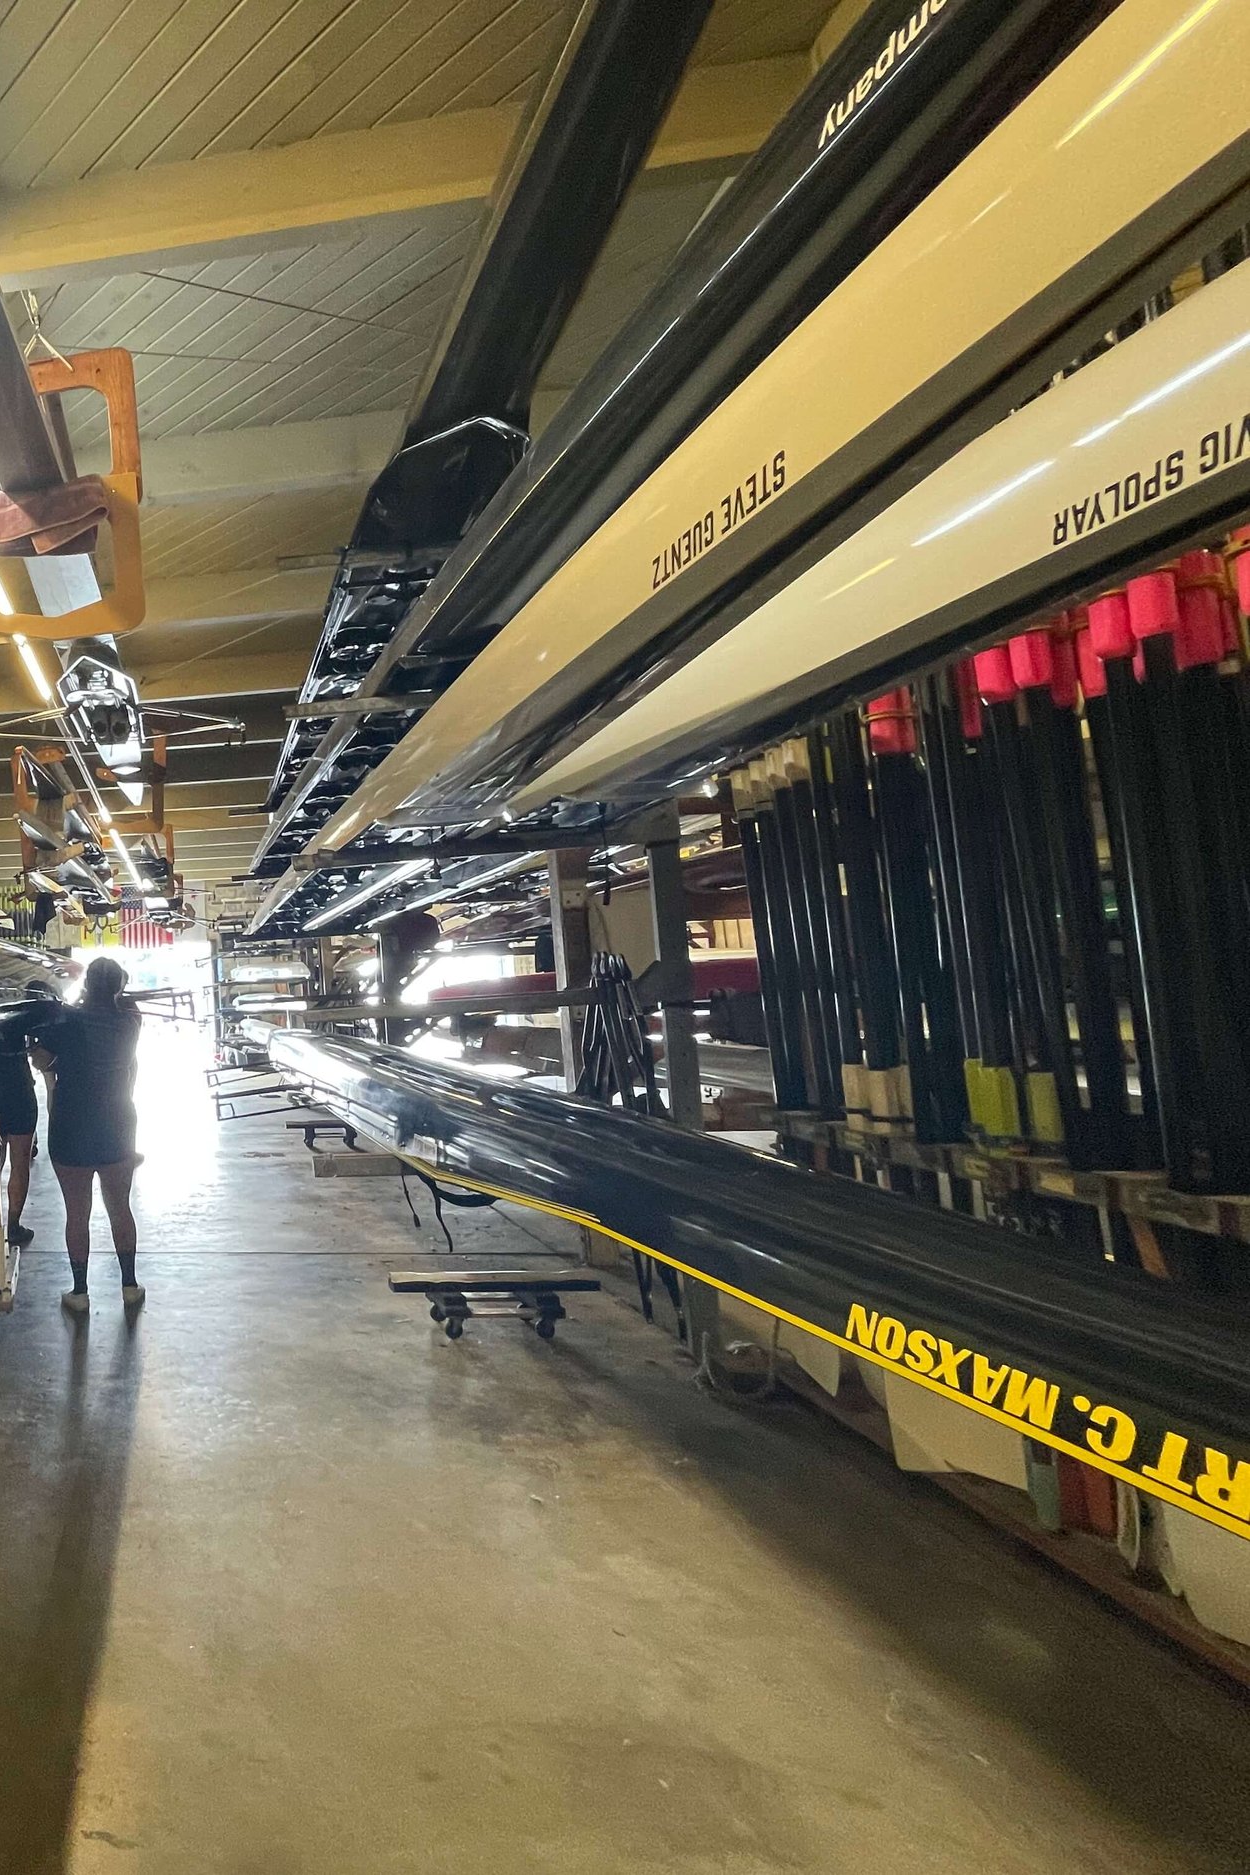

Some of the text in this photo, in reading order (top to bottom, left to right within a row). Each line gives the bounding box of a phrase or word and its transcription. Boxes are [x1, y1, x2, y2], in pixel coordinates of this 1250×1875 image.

[652, 450, 786, 590] STEVE GUENTZ
[1053, 449, 1185, 546] SPOLYAR
[845, 1303, 1060, 1431] MAXSON
[1072, 1395, 1137, 1462] C.
